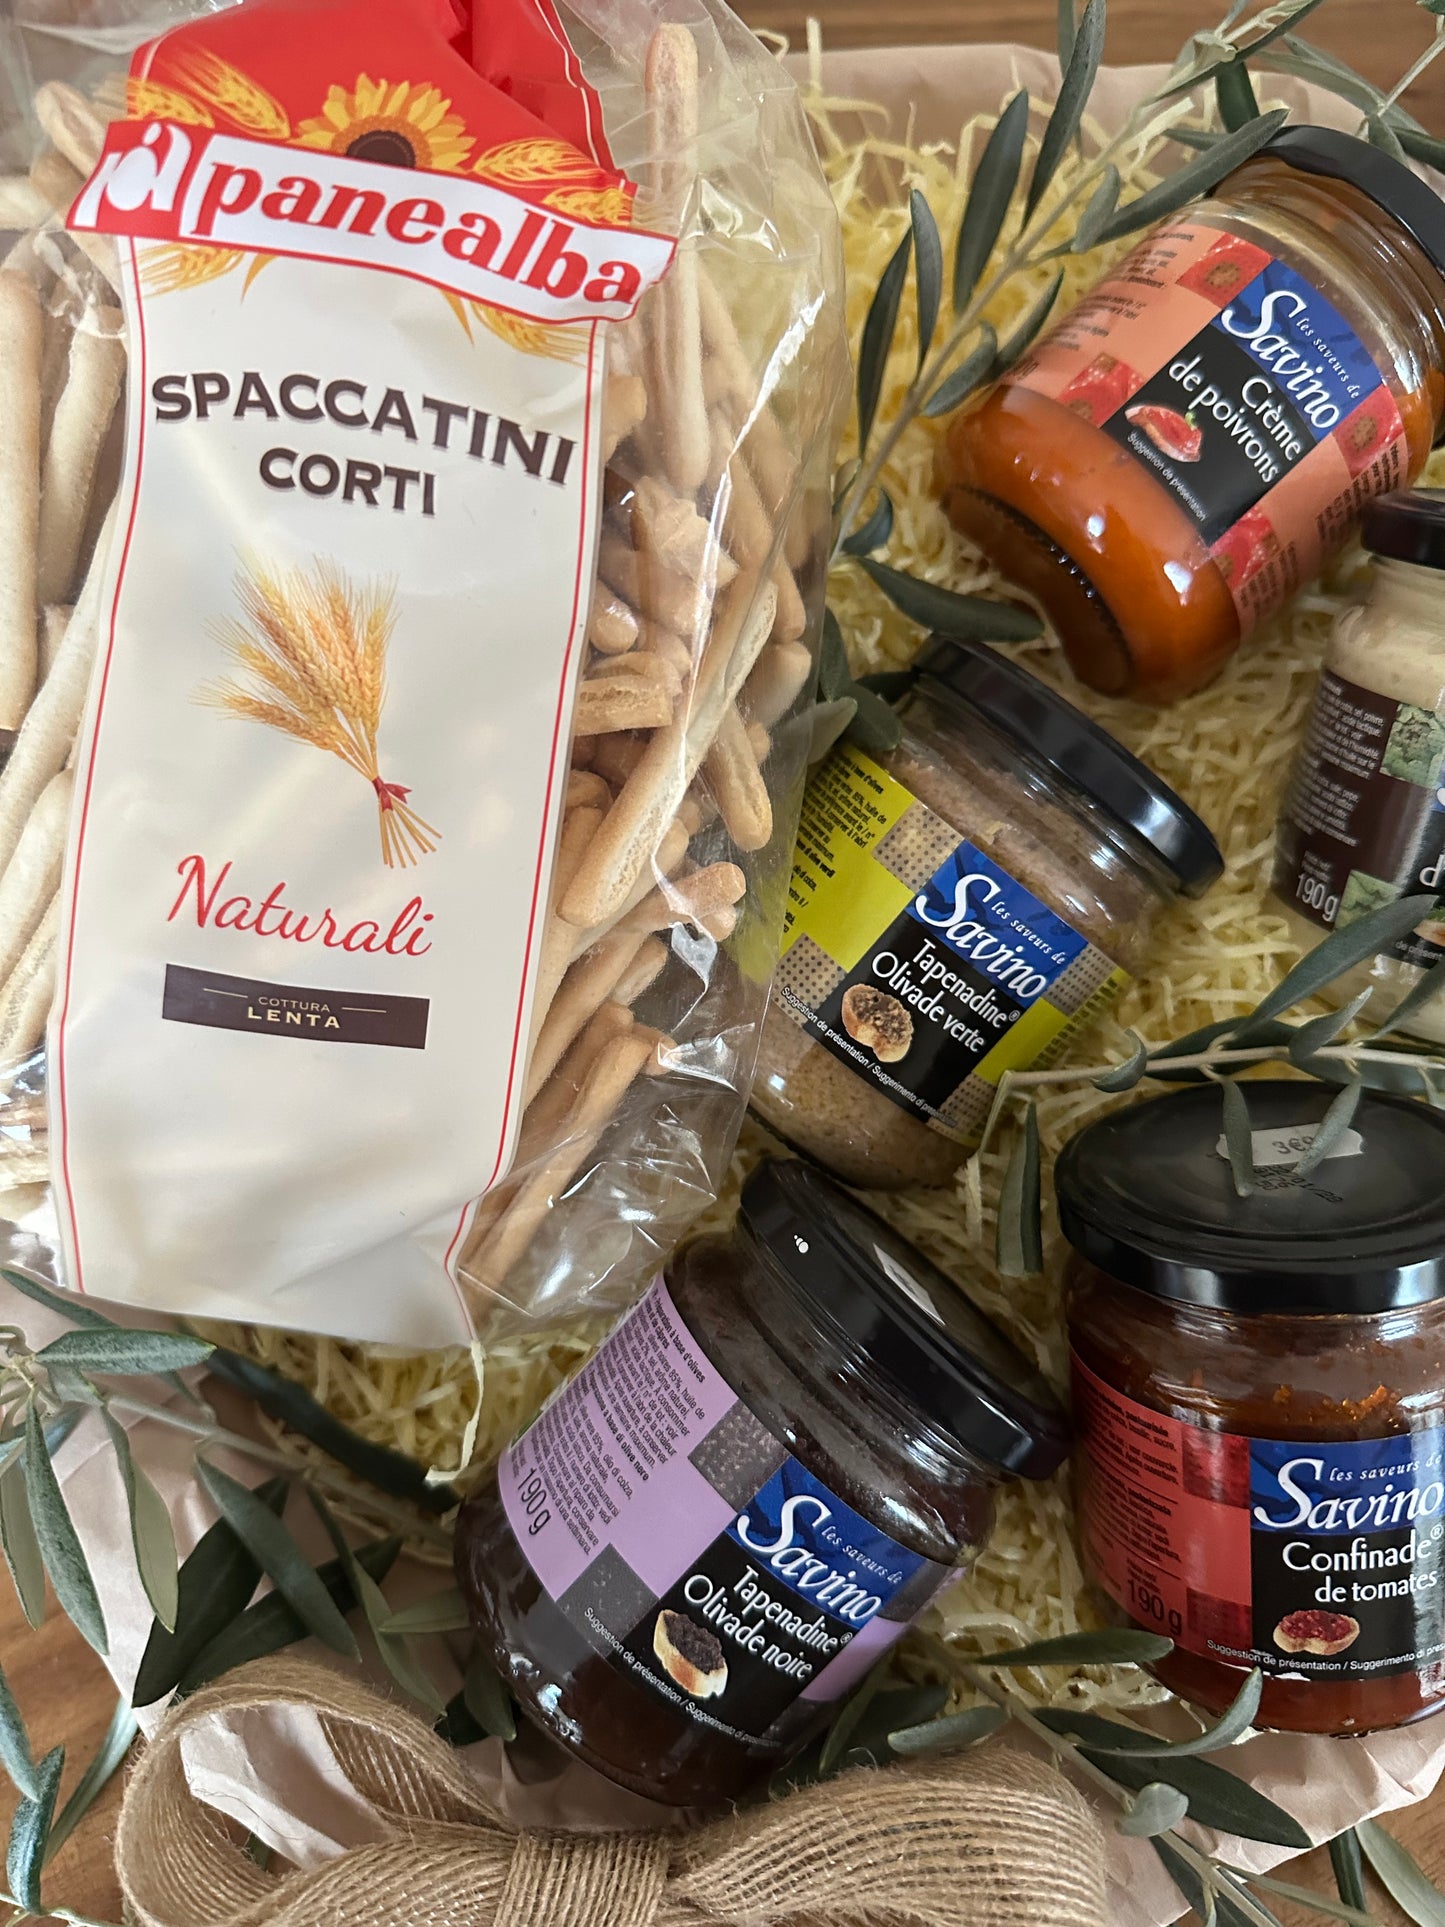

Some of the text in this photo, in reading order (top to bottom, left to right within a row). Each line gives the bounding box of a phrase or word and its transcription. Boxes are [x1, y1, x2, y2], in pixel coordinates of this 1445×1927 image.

[191, 161, 642, 304] panealba
[1222, 290, 1340, 429] Savino
[1296, 316, 1359, 399] les saveurs de
[151, 371, 578, 485] SPACCATINI
[1168, 356, 1201, 393] de
[1190, 386, 1281, 483] poivrons
[1242, 378, 1301, 461] Crème
[260, 449, 434, 515] CORTI
[1125, 431, 1208, 521] Suggestion de présentation
[876, 813, 888, 825] de
[167, 855, 434, 957] Naturali
[1296, 873, 1338, 921] 190 g
[915, 873, 1048, 998] Savino
[991, 899, 1066, 965] les saveurs de
[247, 1006, 341, 1029] LENTA
[258, 995, 331, 1014] COTTURA
[871, 951, 943, 1023] Olivade
[942, 1012, 987, 1053] verte
[780, 986, 818, 1023] Suggestion
[815, 1018, 829, 1032] de
[824, 1027, 870, 1067] présentation
[870, 1064, 917, 1103] Suggerimento
[671, 1334, 687, 1354] base
[681, 1351, 707, 1383] d'olives
[652, 1367, 673, 1391] arôme
[666, 1389, 691, 1419] naturel,
[656, 1393, 690, 1437] consommer
[666, 1368, 686, 1391] 85%,
[680, 1387, 699, 1409] huile
[693, 1406, 707, 1420] de
[606, 1413, 620, 1434] base
[614, 1432, 625, 1443] di
[642, 1410, 655, 1423] de
[647, 1398, 659, 1411] de
[653, 1408, 666, 1422] lot
[663, 1422, 679, 1440] voir
[648, 1419, 660, 1431] la
[619, 1440, 638, 1462] olive
[627, 1428, 657, 1468] maximum.
[640, 1429, 668, 1464] conserver
[653, 1427, 678, 1457] chaleur
[581, 1461, 595, 1475] Da
[610, 1465, 621, 1476] di
[615, 1473, 636, 1500] colza,
[632, 1460, 650, 1481] nere
[1329, 1452, 1442, 1482] les saveurs de
[518, 1468, 547, 1516] 190
[584, 1507, 597, 1521] da
[587, 1472, 620, 1517] consumarsi
[597, 1505, 613, 1524] vedi
[1253, 1458, 1444, 1530] Savino
[528, 1508, 551, 1537] g
[570, 1506, 600, 1546] conservare
[737, 1495, 882, 1619] Savino
[823, 1525, 902, 1585] les saveurs de
[1125, 1579, 1183, 1636] 190 g
[1315, 1570, 1438, 1603] de tomates
[685, 1574, 813, 1679] Olivade noire
[584, 1606, 625, 1653] Suggestion
[621, 1649, 637, 1664] de
[631, 1659, 683, 1703] présentation
[684, 1700, 735, 1736] Suggerimento
[1207, 1639, 1262, 1663] Suggestion
[1263, 1653, 1276, 1666] de
[1278, 1657, 1341, 1671] présentation
[1350, 1651, 1416, 1670] Suggerimento
